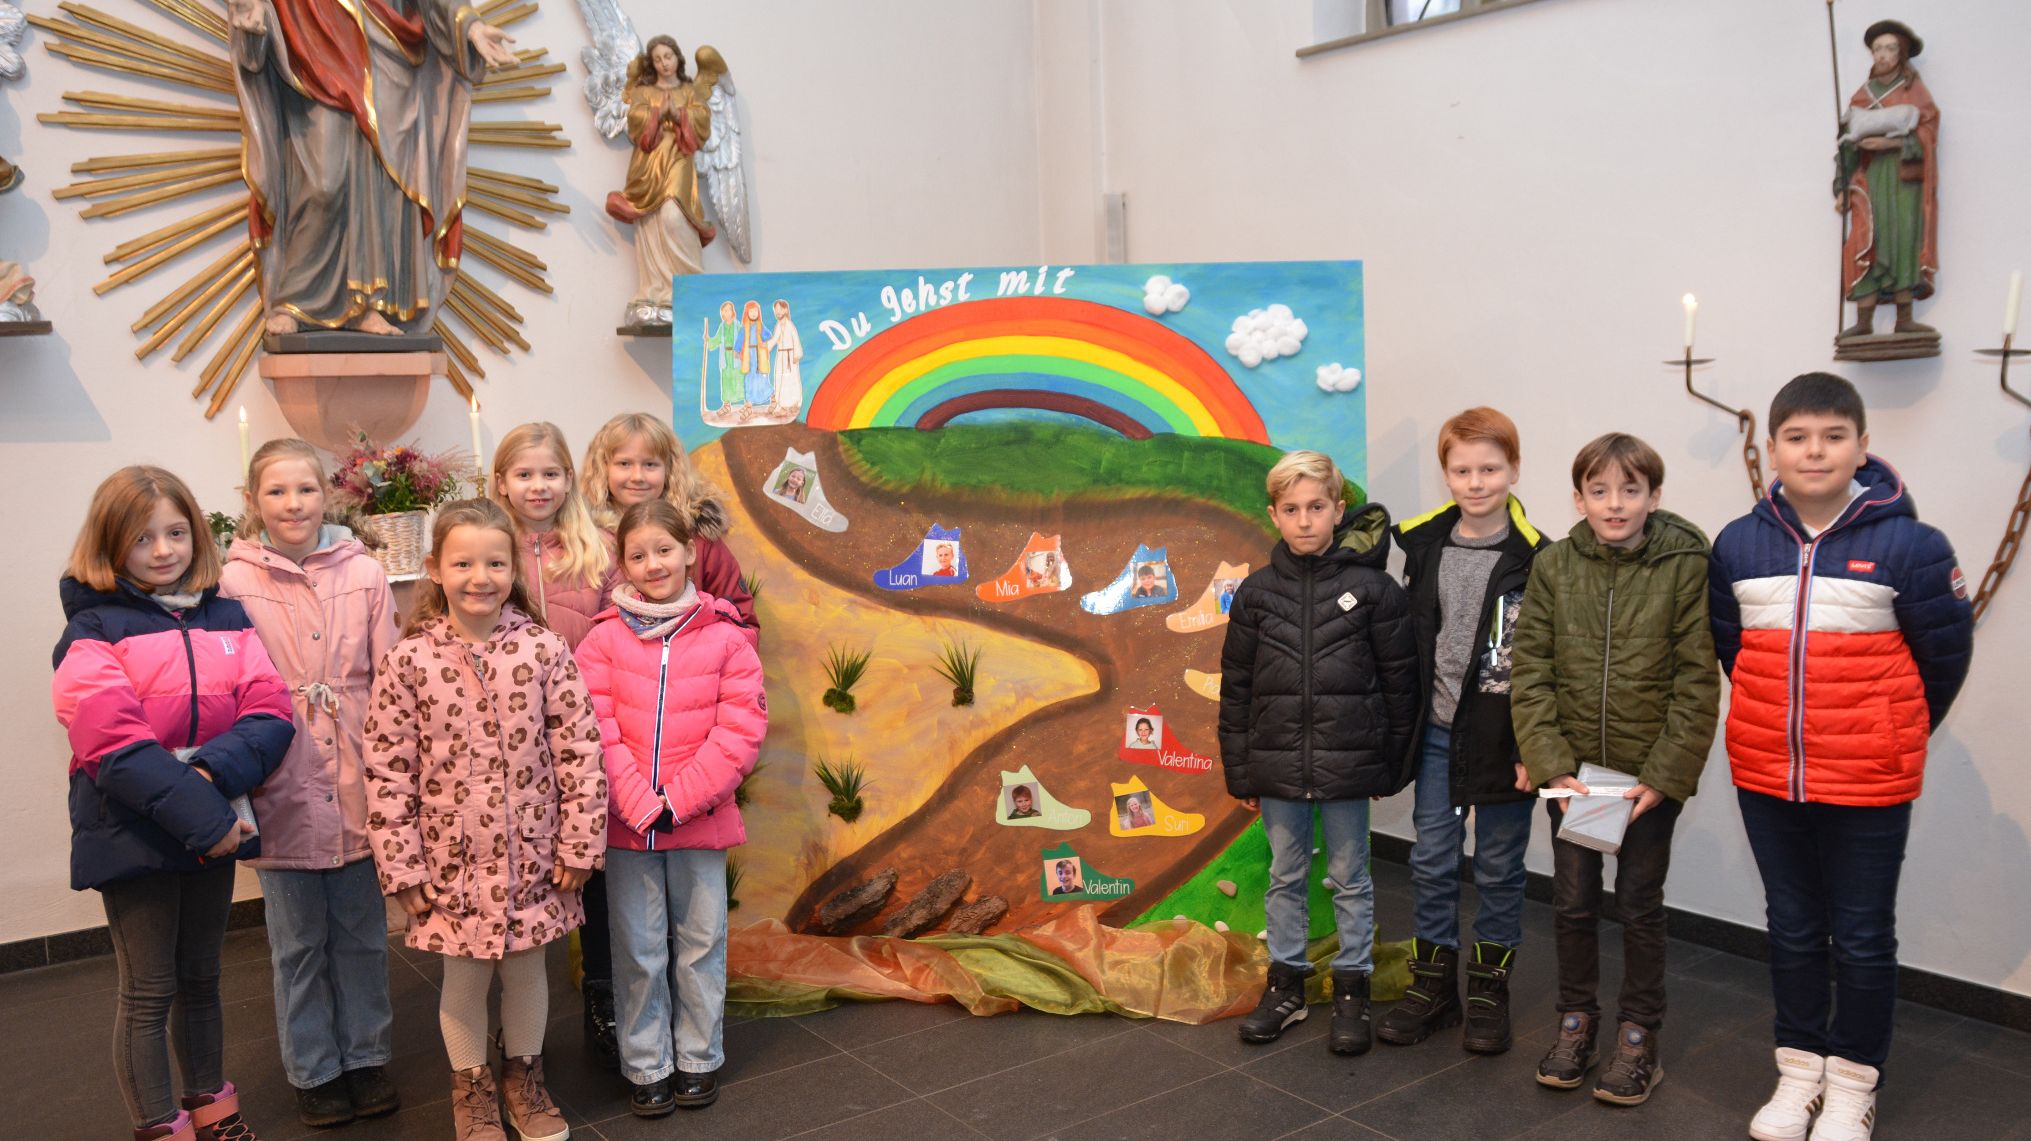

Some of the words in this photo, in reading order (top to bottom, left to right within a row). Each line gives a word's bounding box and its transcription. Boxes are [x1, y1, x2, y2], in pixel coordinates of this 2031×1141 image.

[819, 311, 871, 350] Du
[881, 271, 973, 322] gehst
[997, 265, 1075, 296] mit
[810, 503, 833, 524] Ella
[889, 569, 918, 586] Luan
[995, 581, 1020, 597] Mia
[1157, 750, 1213, 770] Valentina
[1048, 808, 1082, 825] Anton
[1164, 815, 1189, 833] Suri
[1082, 879, 1130, 895] Valentin
